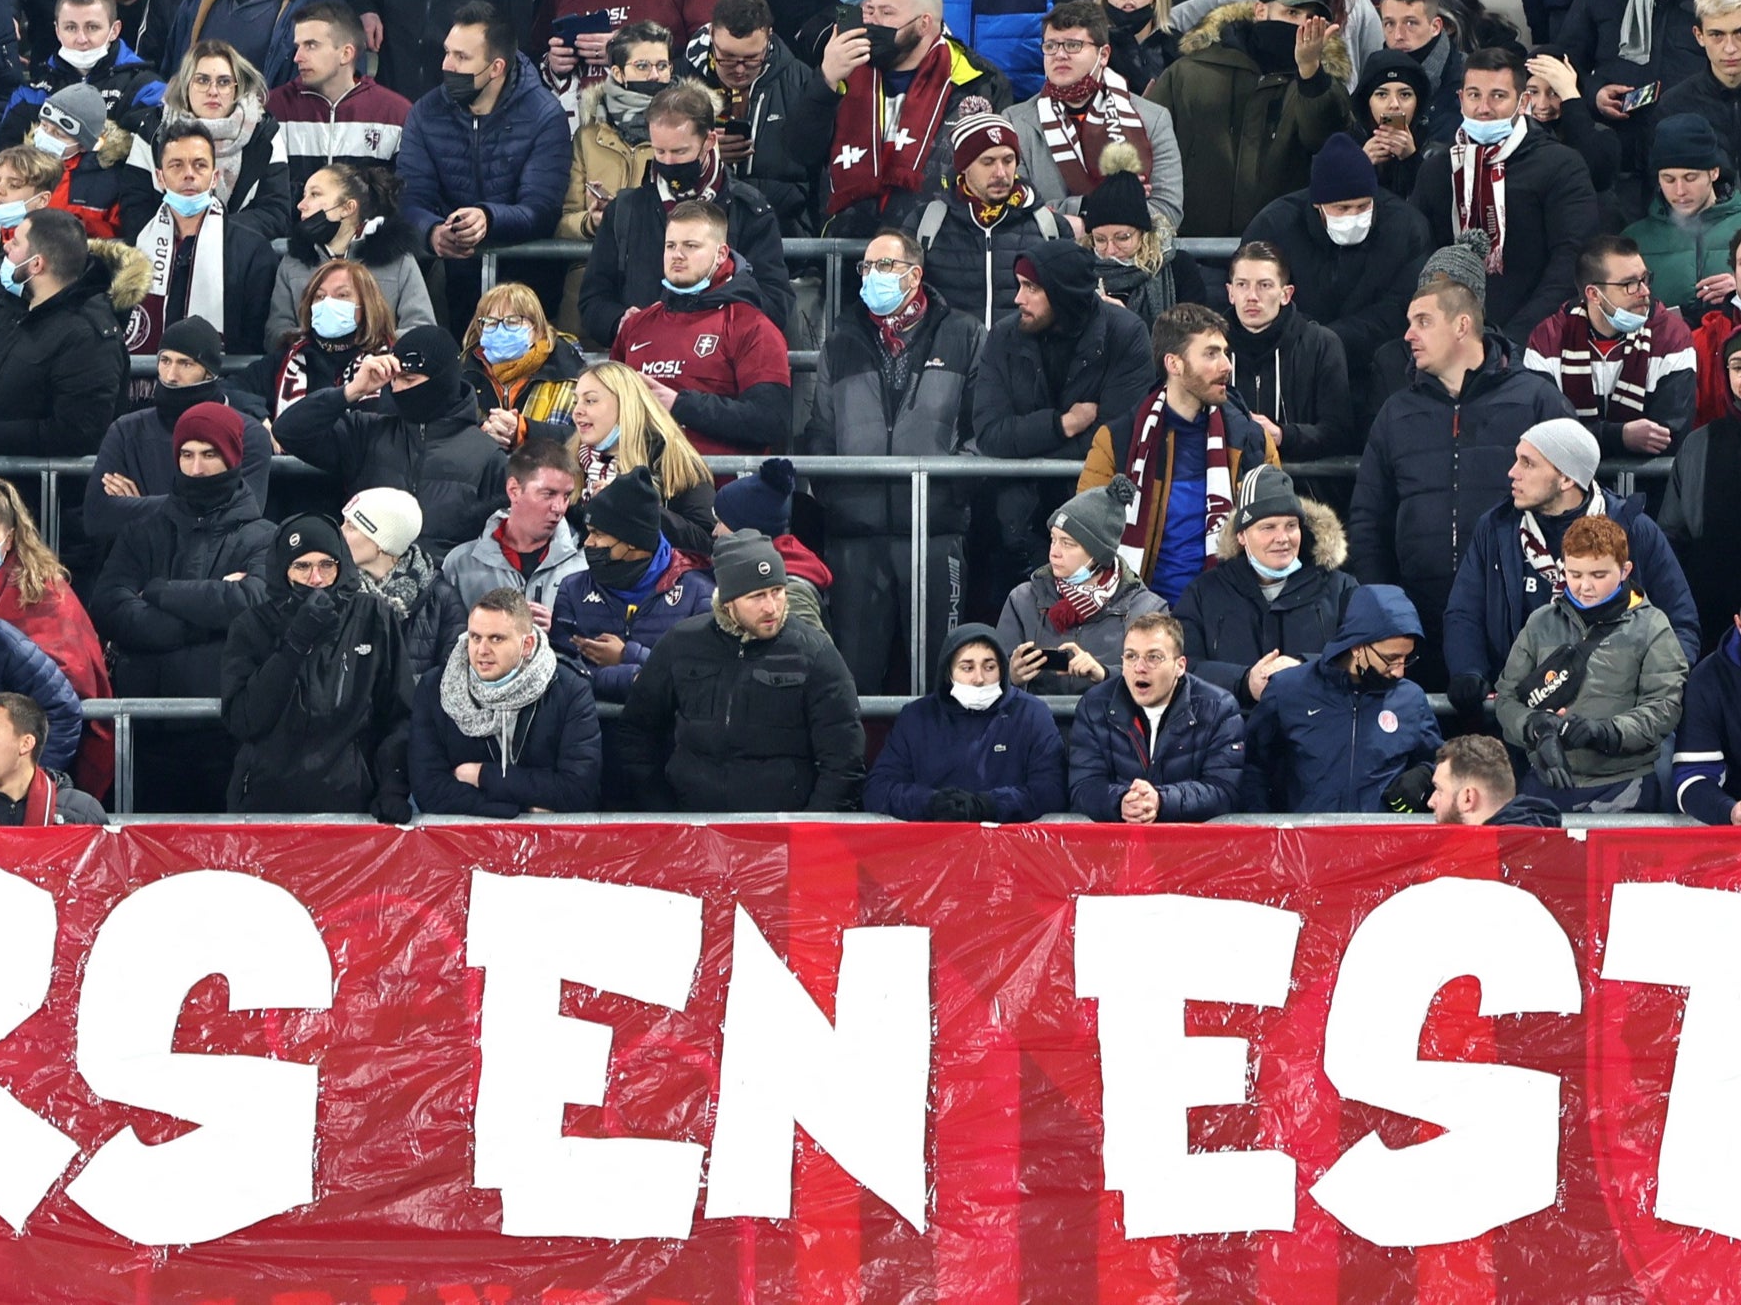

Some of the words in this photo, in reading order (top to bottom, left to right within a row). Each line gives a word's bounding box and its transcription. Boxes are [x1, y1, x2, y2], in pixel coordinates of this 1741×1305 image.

[1524, 576, 1538, 593] B
[1527, 670, 1569, 709] ellesse
[466, 870, 931, 1241] EN
